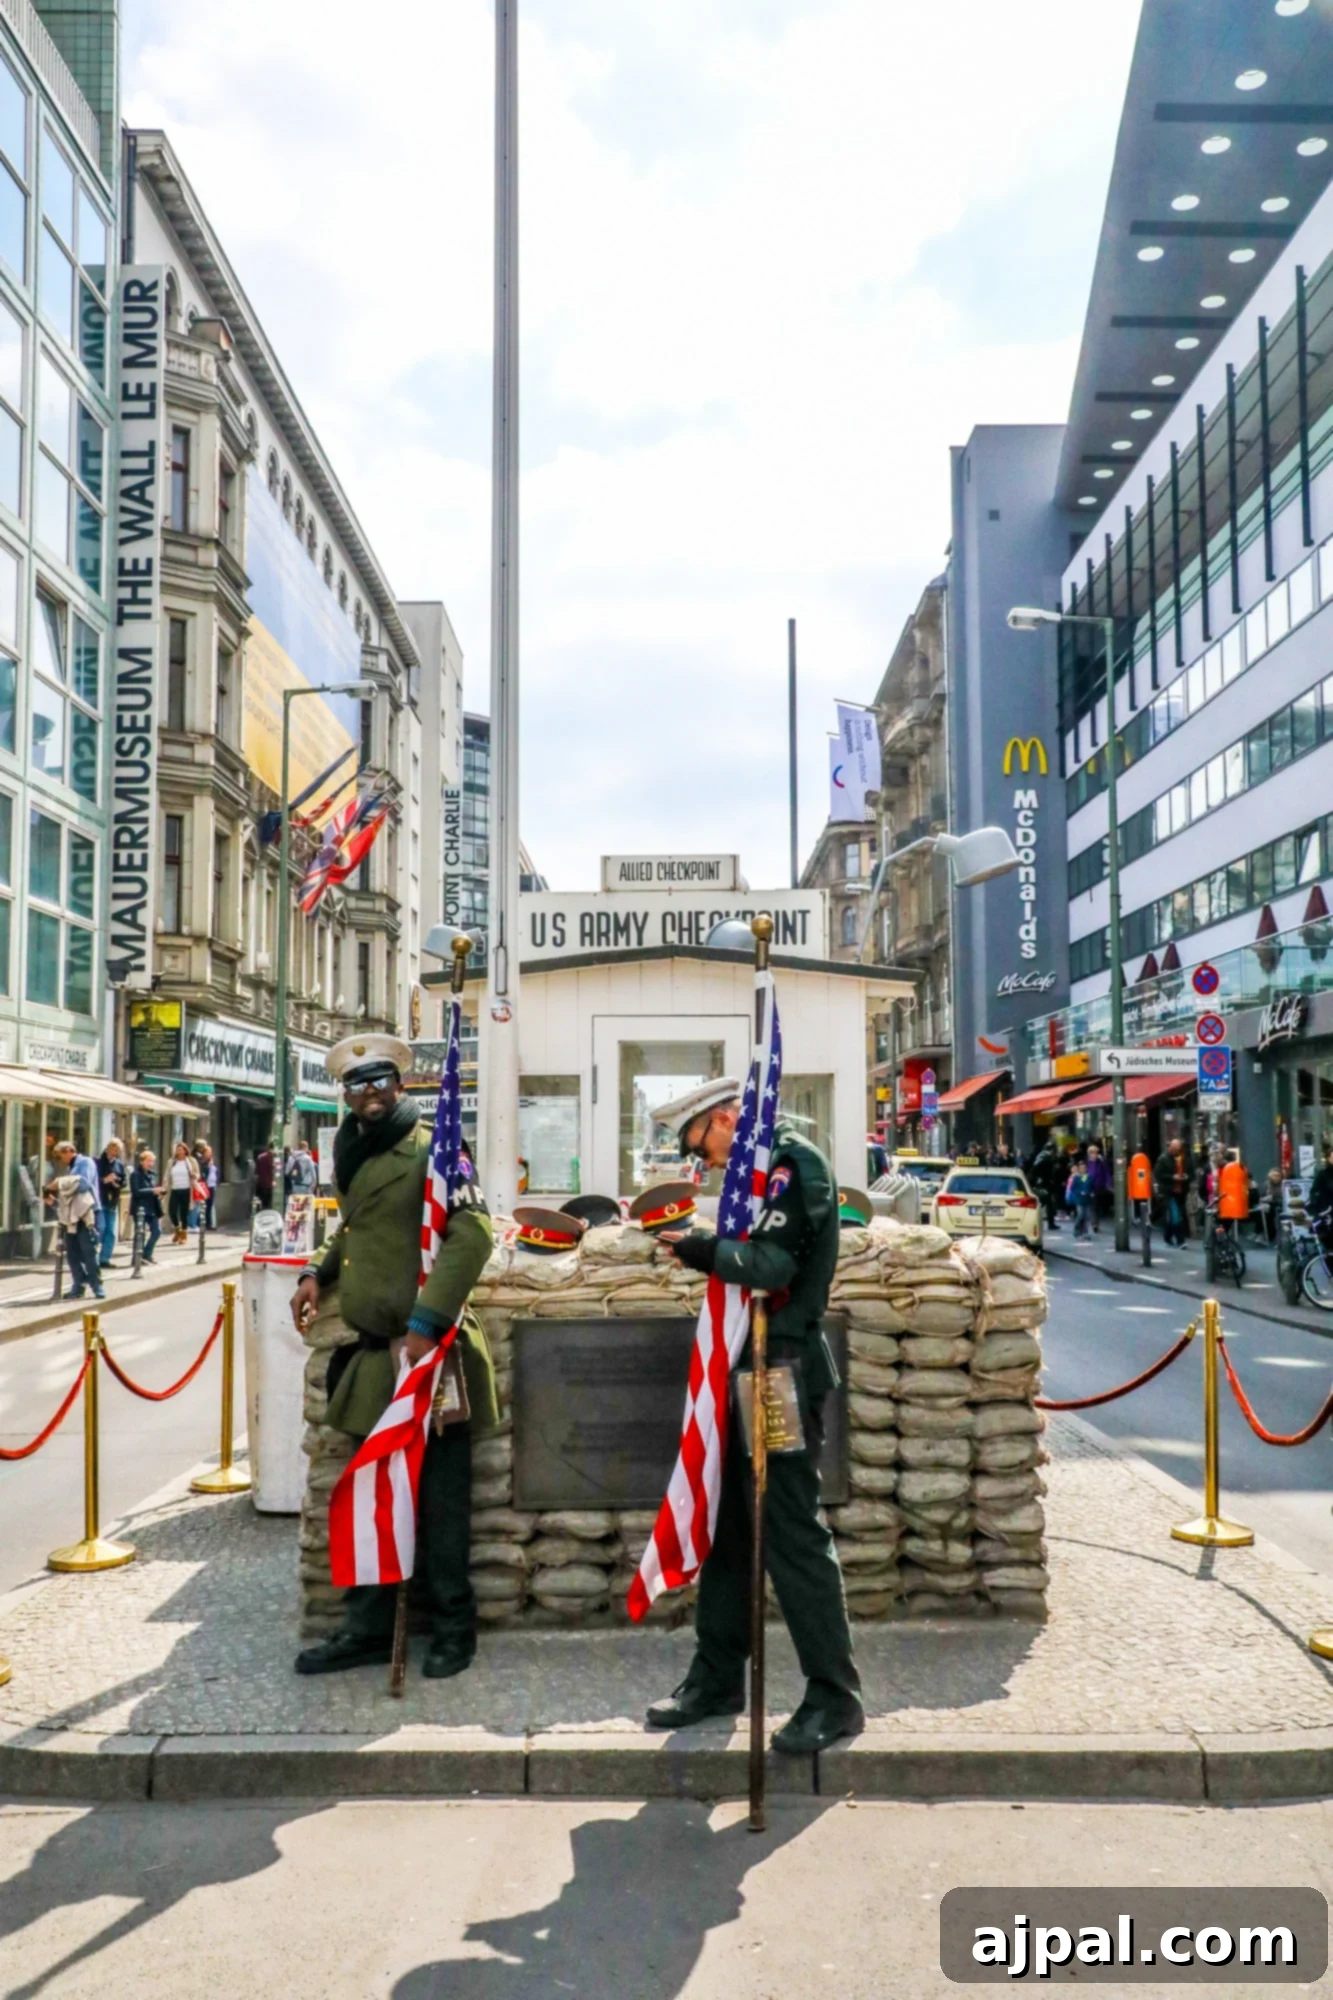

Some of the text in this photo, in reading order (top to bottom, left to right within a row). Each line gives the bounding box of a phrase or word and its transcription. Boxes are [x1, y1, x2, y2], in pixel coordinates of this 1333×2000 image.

[111, 279, 159, 972] MAUERMUSEUM THE WALL LE MUR
[444, 790, 460, 867] CHARLIE
[619, 861, 721, 882] ALLIED CHECKPOINT
[530, 911, 566, 948] US
[579, 911, 650, 948] ARMY
[1125, 1056, 1198, 1066] Jüdisches Museum
